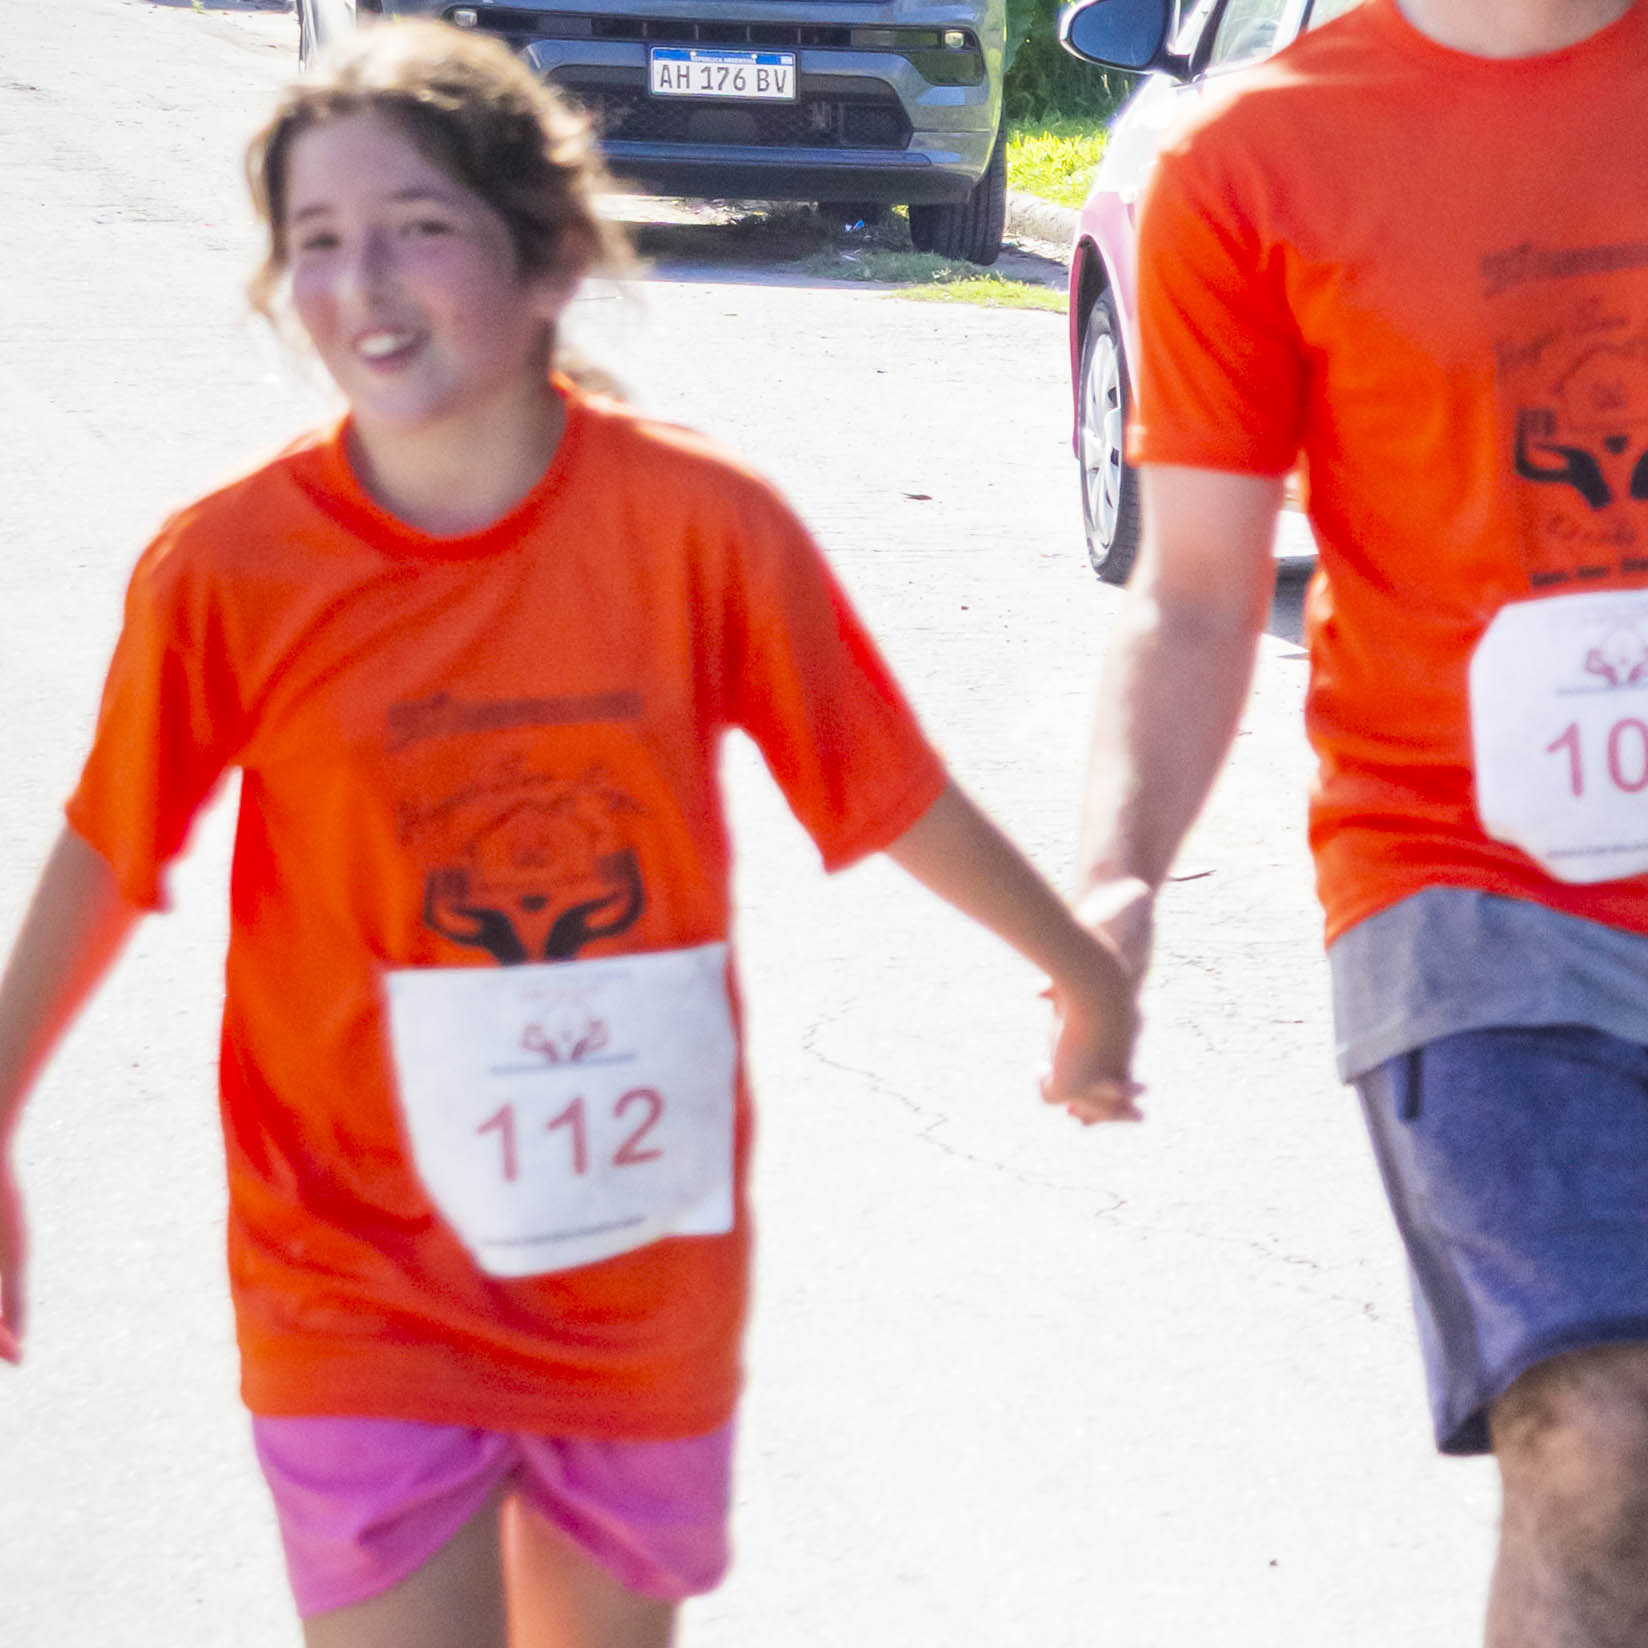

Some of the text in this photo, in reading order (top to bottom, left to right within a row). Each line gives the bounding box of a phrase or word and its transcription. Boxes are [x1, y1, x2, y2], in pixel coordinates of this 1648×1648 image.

[660, 64, 786, 93] AH 176 BV
[476, 1085, 665, 1182] 112
